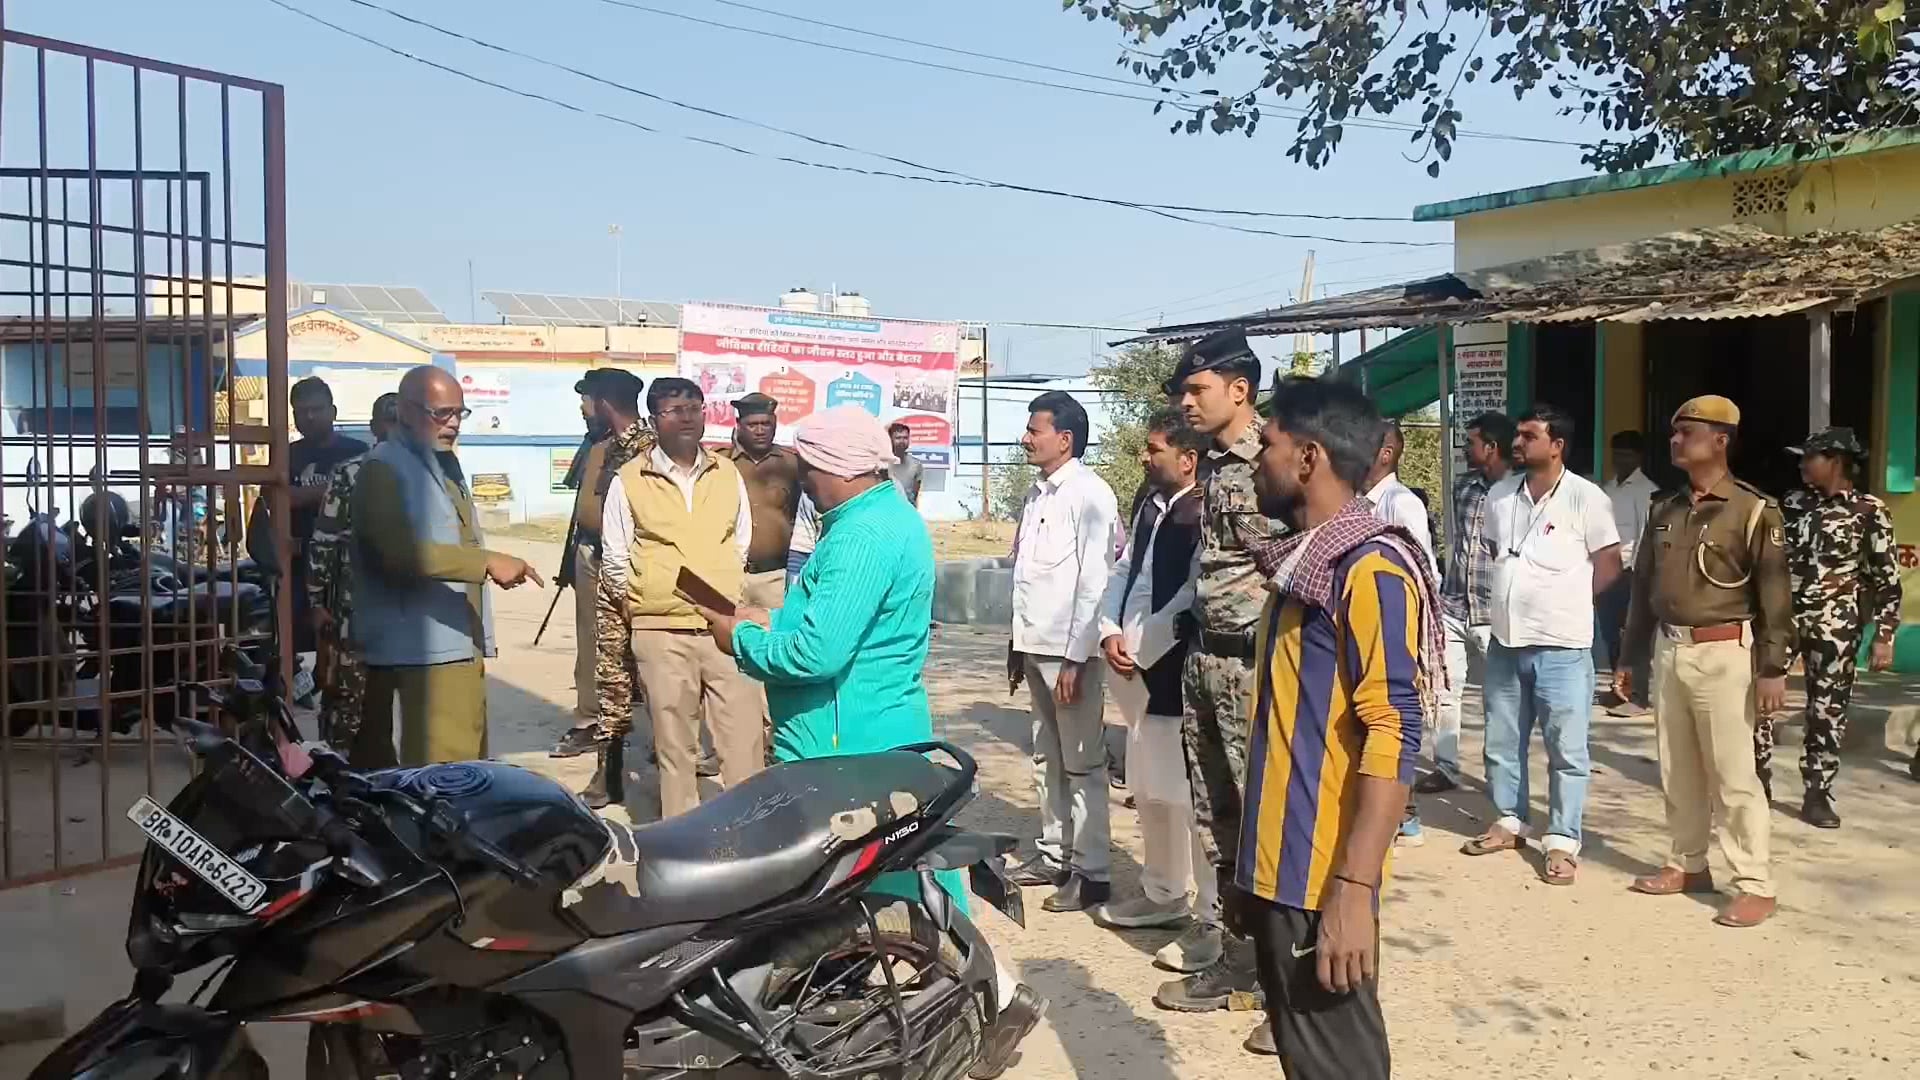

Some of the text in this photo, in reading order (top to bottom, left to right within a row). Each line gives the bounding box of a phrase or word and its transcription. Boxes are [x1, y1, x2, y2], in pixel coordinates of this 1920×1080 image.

[757, 340, 790, 354] दीदियों
[791, 345, 805, 356] का
[857, 351, 876, 363] हुआ
[877, 350, 895, 362] और
[168, 828, 215, 872] 10AR
[210, 861, 257, 904] 6422
